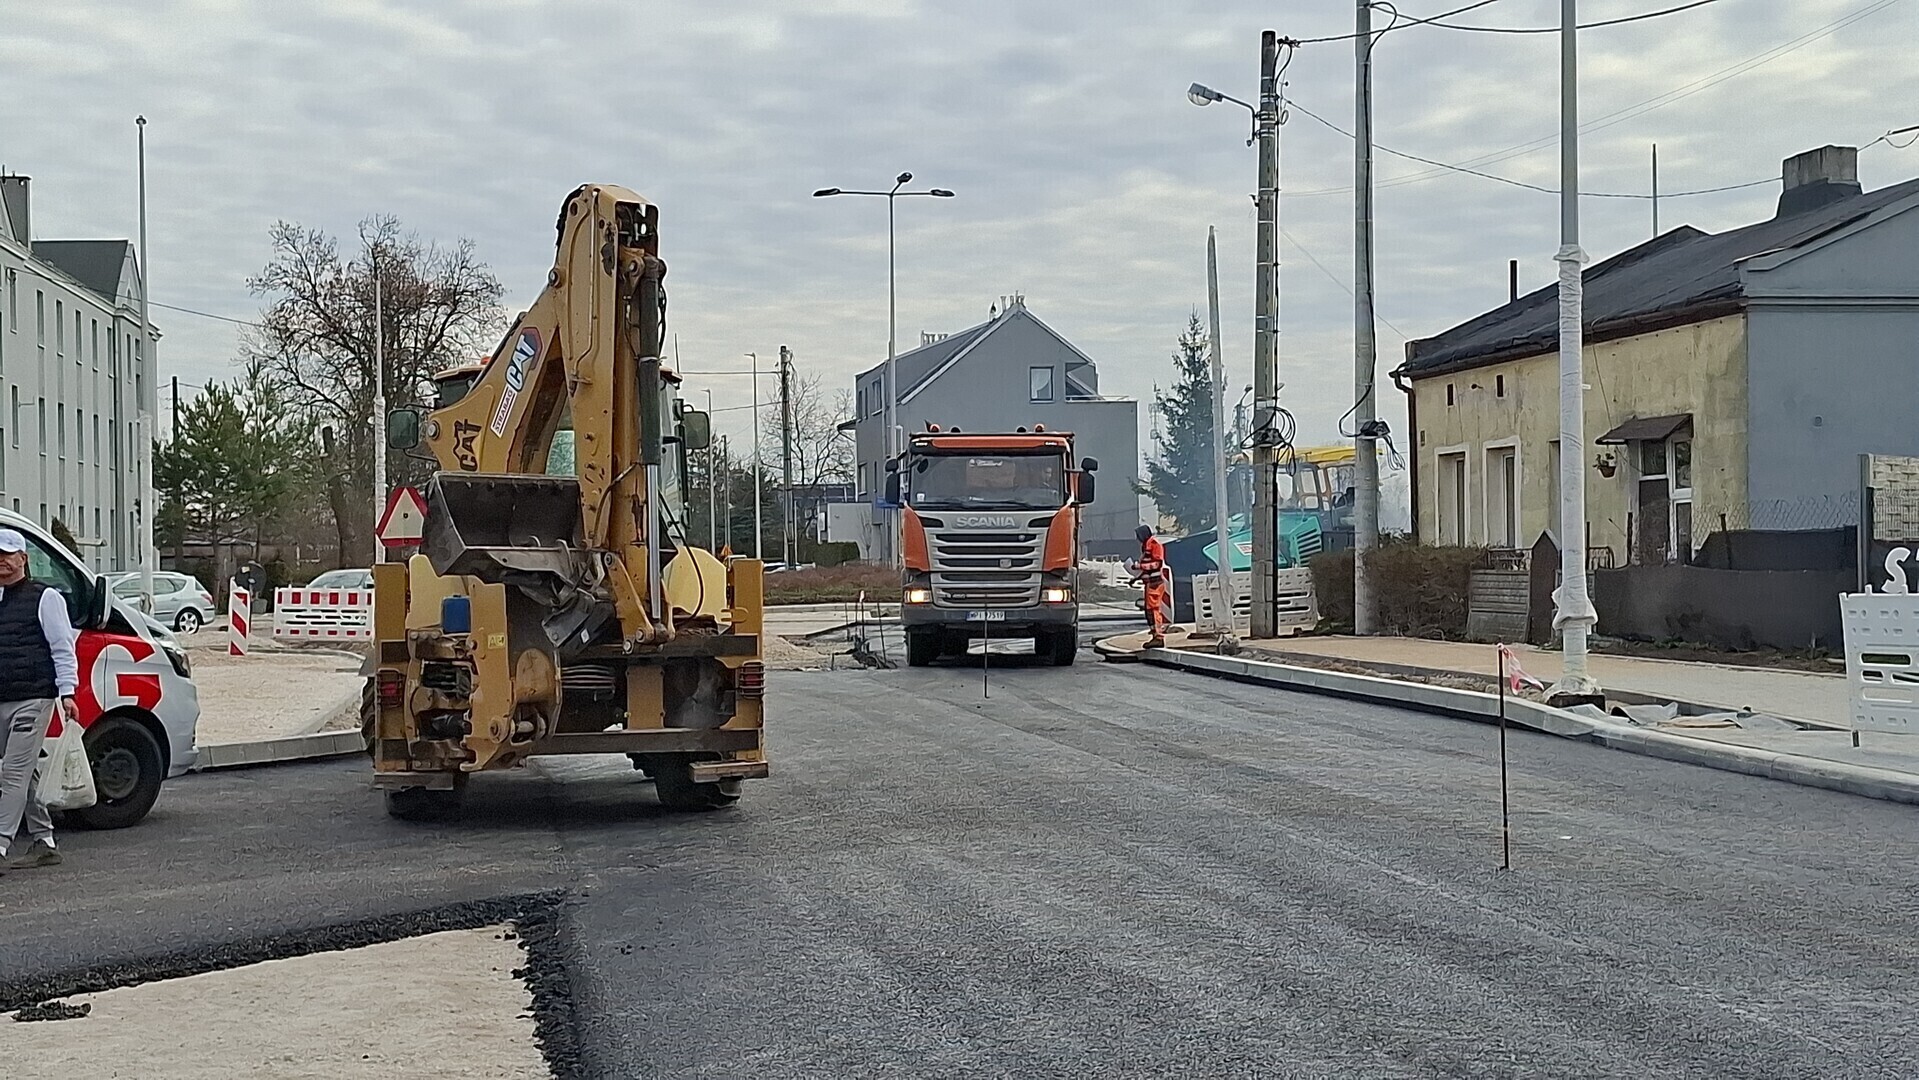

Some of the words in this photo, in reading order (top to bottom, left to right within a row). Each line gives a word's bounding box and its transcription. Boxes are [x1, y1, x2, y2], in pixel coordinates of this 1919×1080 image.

[506, 334, 537, 392] CAT
[493, 389, 516, 432] STRABAG
[453, 419, 482, 472] CAT
[956, 516, 1016, 527] SCANIA
